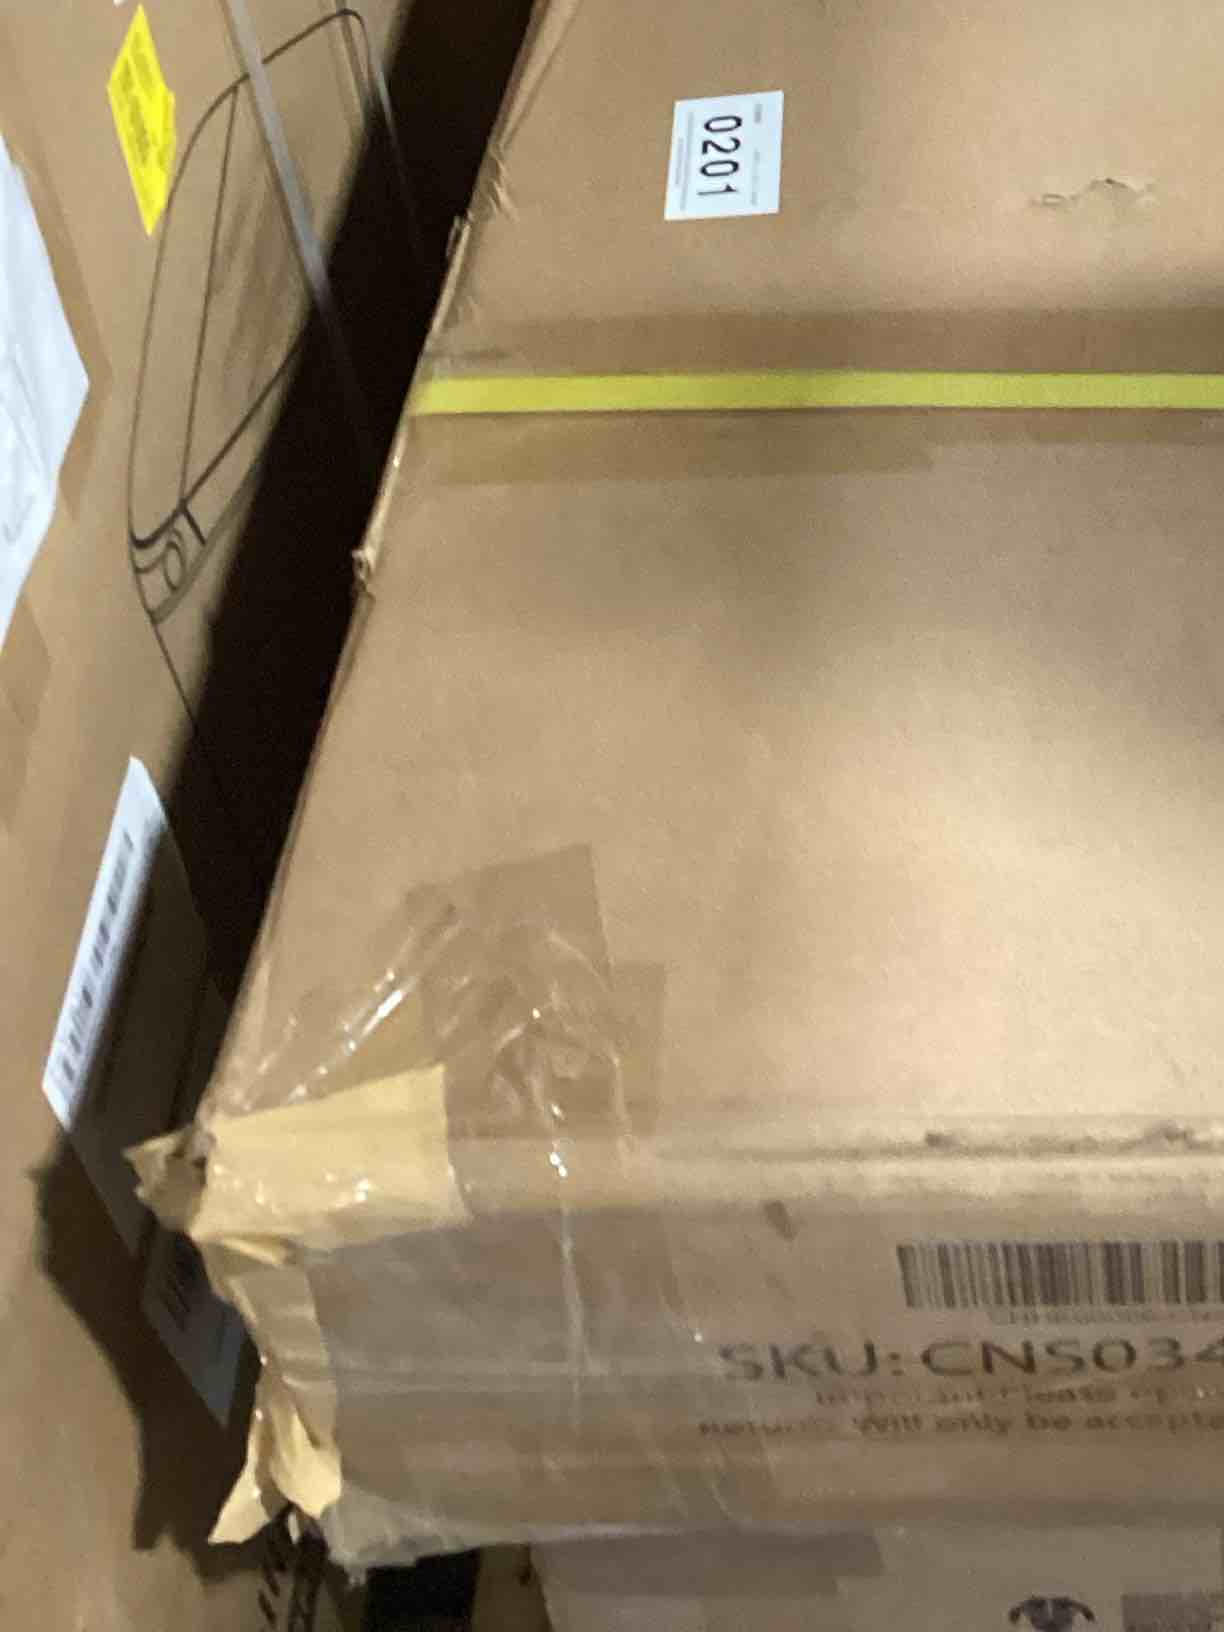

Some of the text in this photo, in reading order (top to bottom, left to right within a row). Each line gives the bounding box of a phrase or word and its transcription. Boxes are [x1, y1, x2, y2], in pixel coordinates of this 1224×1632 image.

[696, 115, 743, 197] 0201
[718, 1340, 904, 1382] SKU:
[1026, 1410, 1072, 1432] be
